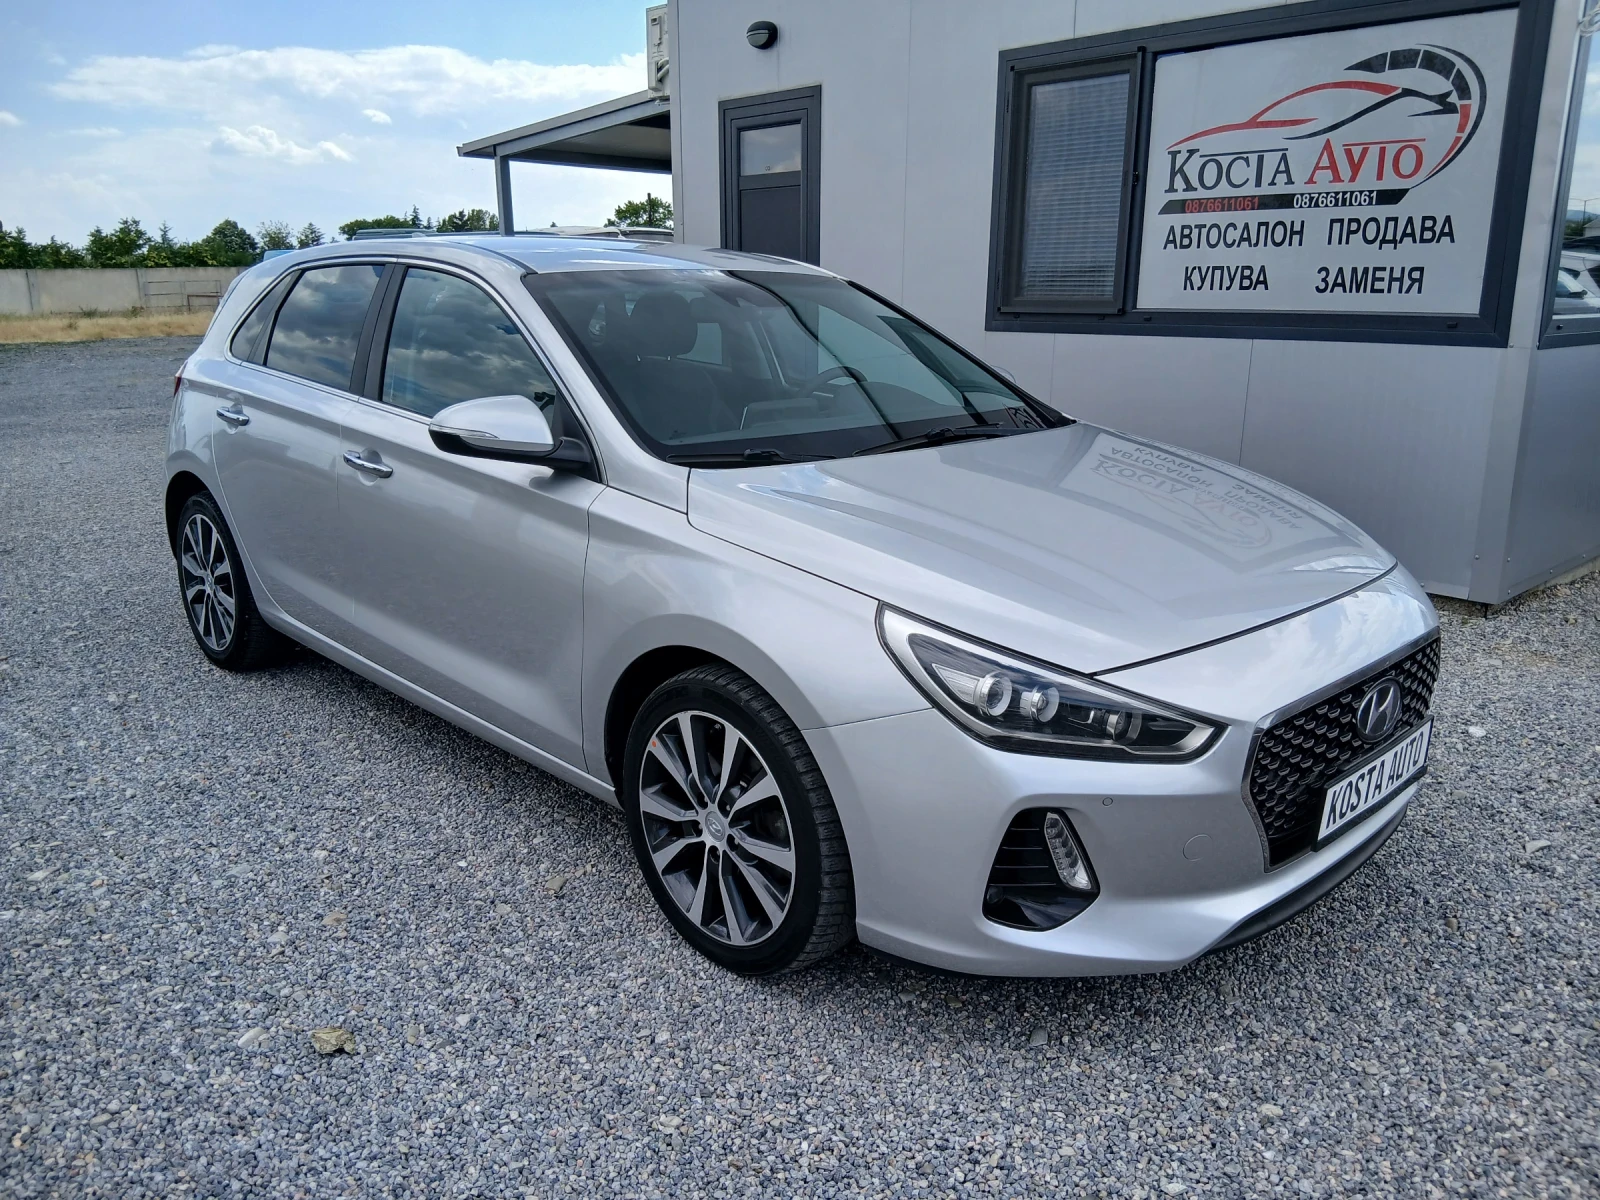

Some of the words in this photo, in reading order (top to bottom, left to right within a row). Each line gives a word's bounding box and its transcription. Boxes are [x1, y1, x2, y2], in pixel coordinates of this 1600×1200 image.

[1185, 197, 1260, 214] 0876611061
[1293, 191, 1378, 209] 0876611061
[1163, 220, 1305, 250] АВТОСАЛОН
[1327, 215, 1456, 250] ПРОДАВА
[1183, 265, 1269, 291] КУПУВА
[1315, 266, 1425, 294] ЗАМЕНЯ
[1325, 759, 1386, 830] KOSTA
[1385, 731, 1424, 790] AUTO
